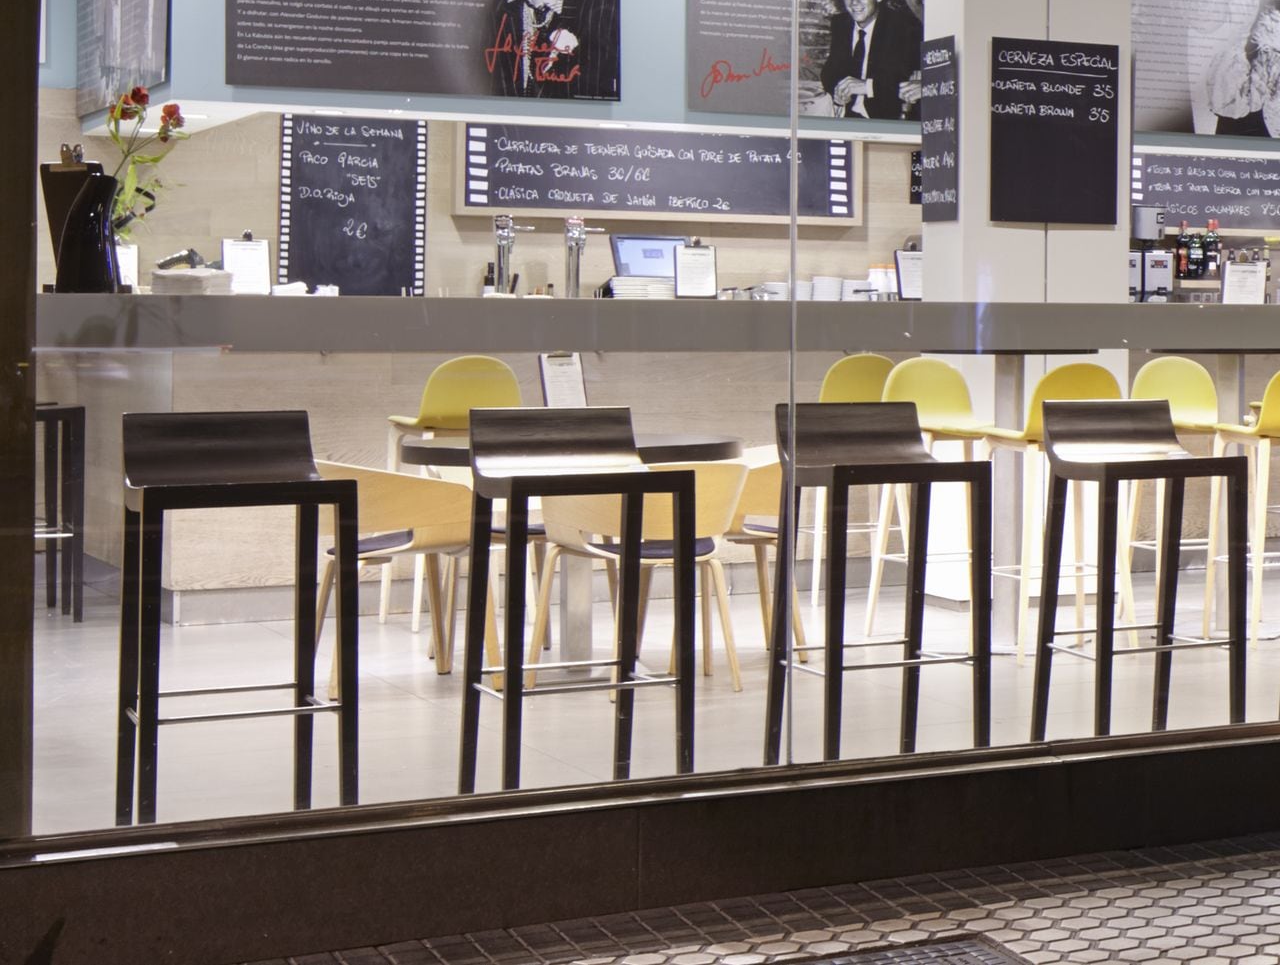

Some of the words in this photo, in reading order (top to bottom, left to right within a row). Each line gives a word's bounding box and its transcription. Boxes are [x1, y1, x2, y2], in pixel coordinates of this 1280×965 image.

[999, 50, 1054, 67] CERVEZA
[1059, 51, 1118, 70] ESPECIAL
[1040, 81, 1086, 96] BLONDE
[1039, 105, 1075, 119] BROWN
[325, 125, 339, 136] DE
[344, 126, 357, 136] LA
[299, 150, 328, 165] PACO
[565, 144, 579, 155] DE
[584, 143, 631, 158] TERNERA
[729, 152, 742, 164] DE
[553, 165, 599, 181] BRAVAS
[602, 192, 618, 203] DE
